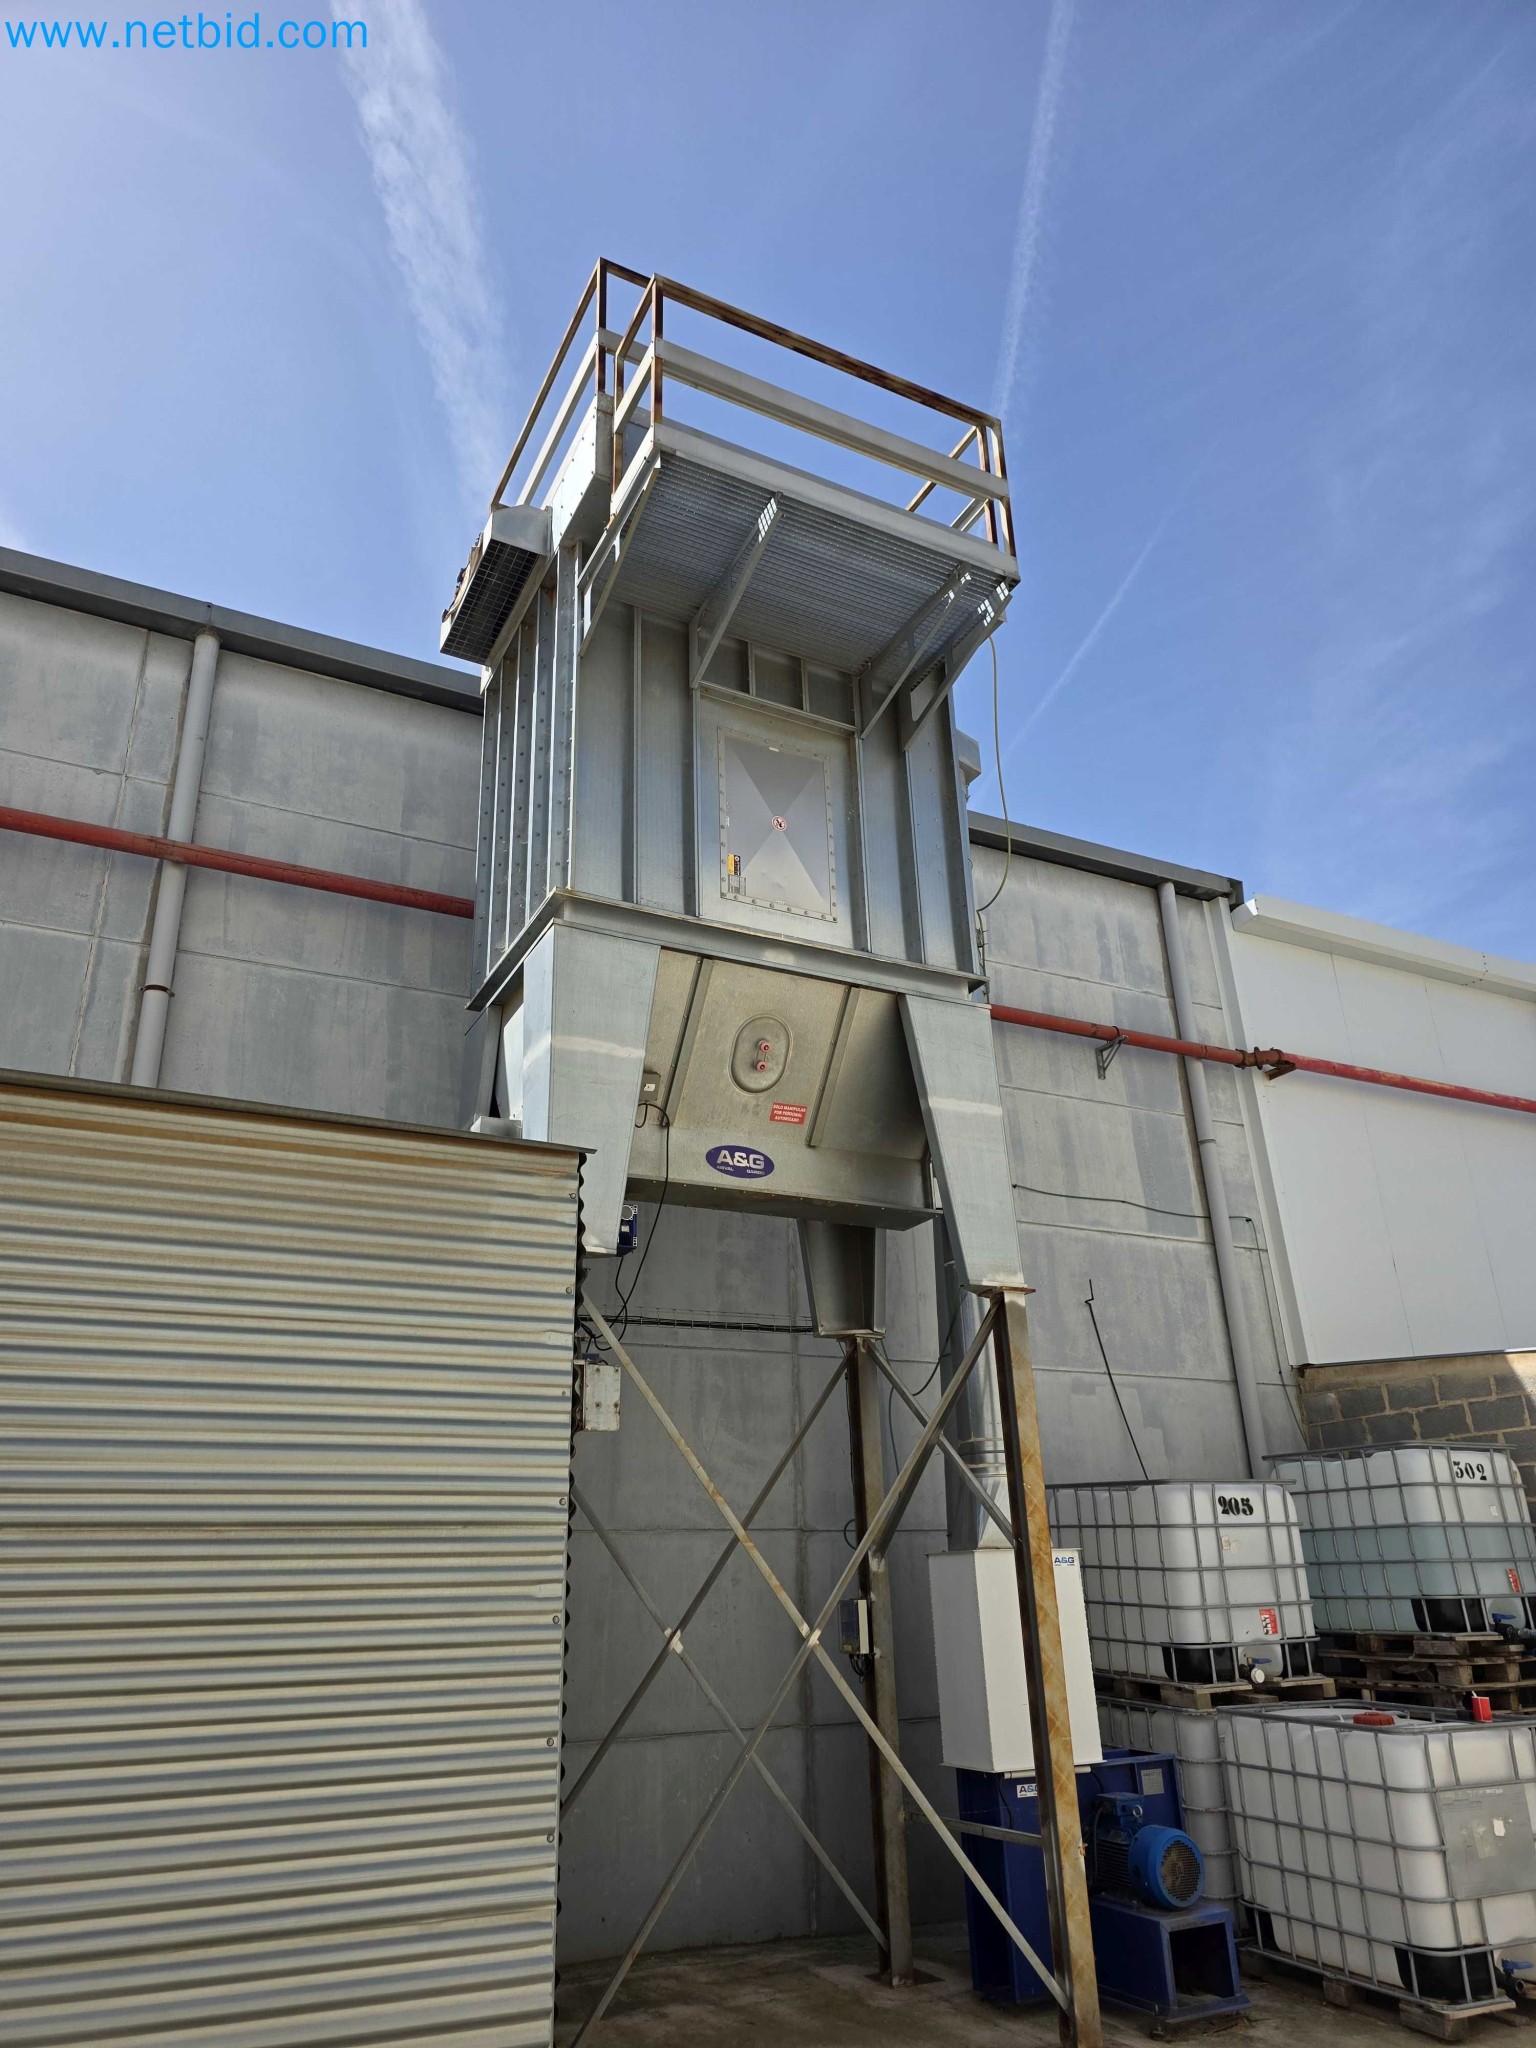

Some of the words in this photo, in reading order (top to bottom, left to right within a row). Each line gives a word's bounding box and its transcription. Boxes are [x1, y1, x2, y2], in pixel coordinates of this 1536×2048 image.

[716, 1149, 765, 1170] A&G
[1218, 1496, 1254, 1516] 205
[1054, 1556, 1074, 1564] A&G
